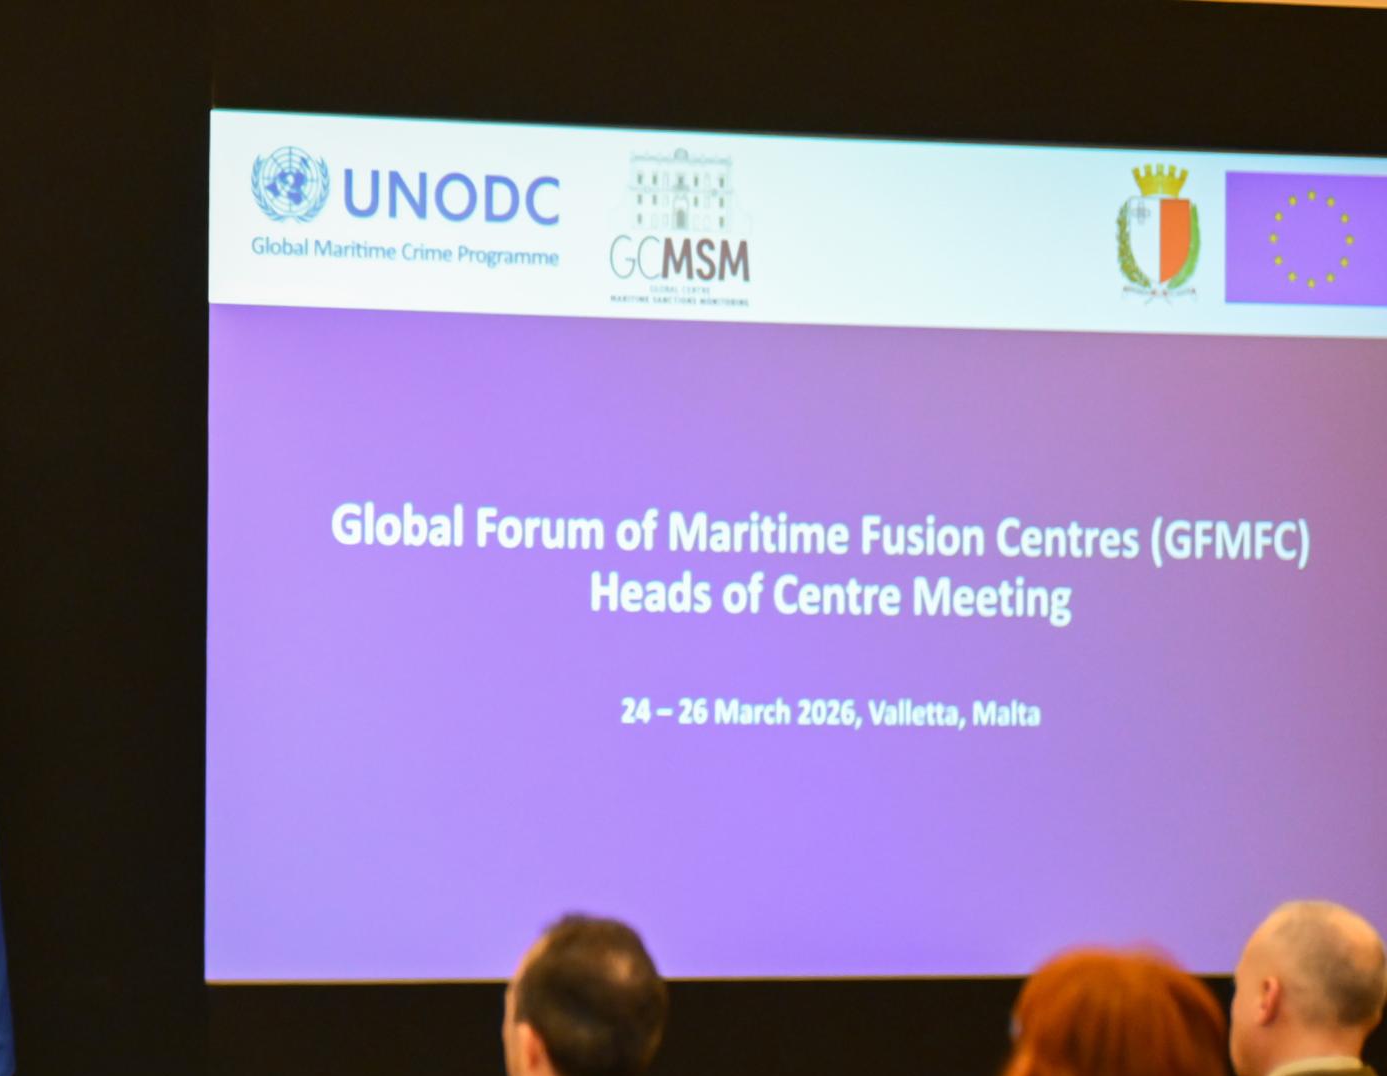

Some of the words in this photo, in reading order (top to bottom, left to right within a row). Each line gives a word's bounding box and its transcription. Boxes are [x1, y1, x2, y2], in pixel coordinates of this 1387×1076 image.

[343, 168, 560, 226] UNODC
[251, 235, 309, 257] Global
[313, 239, 397, 261] Maritime
[401, 242, 453, 263] Crime
[457, 245, 560, 269] Programme
[609, 234, 751, 283] GCMSM
[331, 501, 464, 548] Global
[476, 506, 605, 549] Forum
[615, 507, 659, 551] of
[669, 511, 850, 554] Maritime
[861, 514, 985, 557] Fusion
[996, 517, 1141, 559] Centres
[1151, 516, 1311, 570] (GFMFC)
[590, 570, 712, 614] Heads
[722, 571, 765, 614] of
[773, 574, 901, 617] Centre
[913, 576, 1073, 628] Meeting
[621, 697, 652, 724] 24
[678, 697, 709, 725] 26
[714, 697, 792, 726] March
[797, 698, 863, 730] 2026,
[868, 699, 966, 730] Valletta,
[972, 700, 1041, 726] Malta
